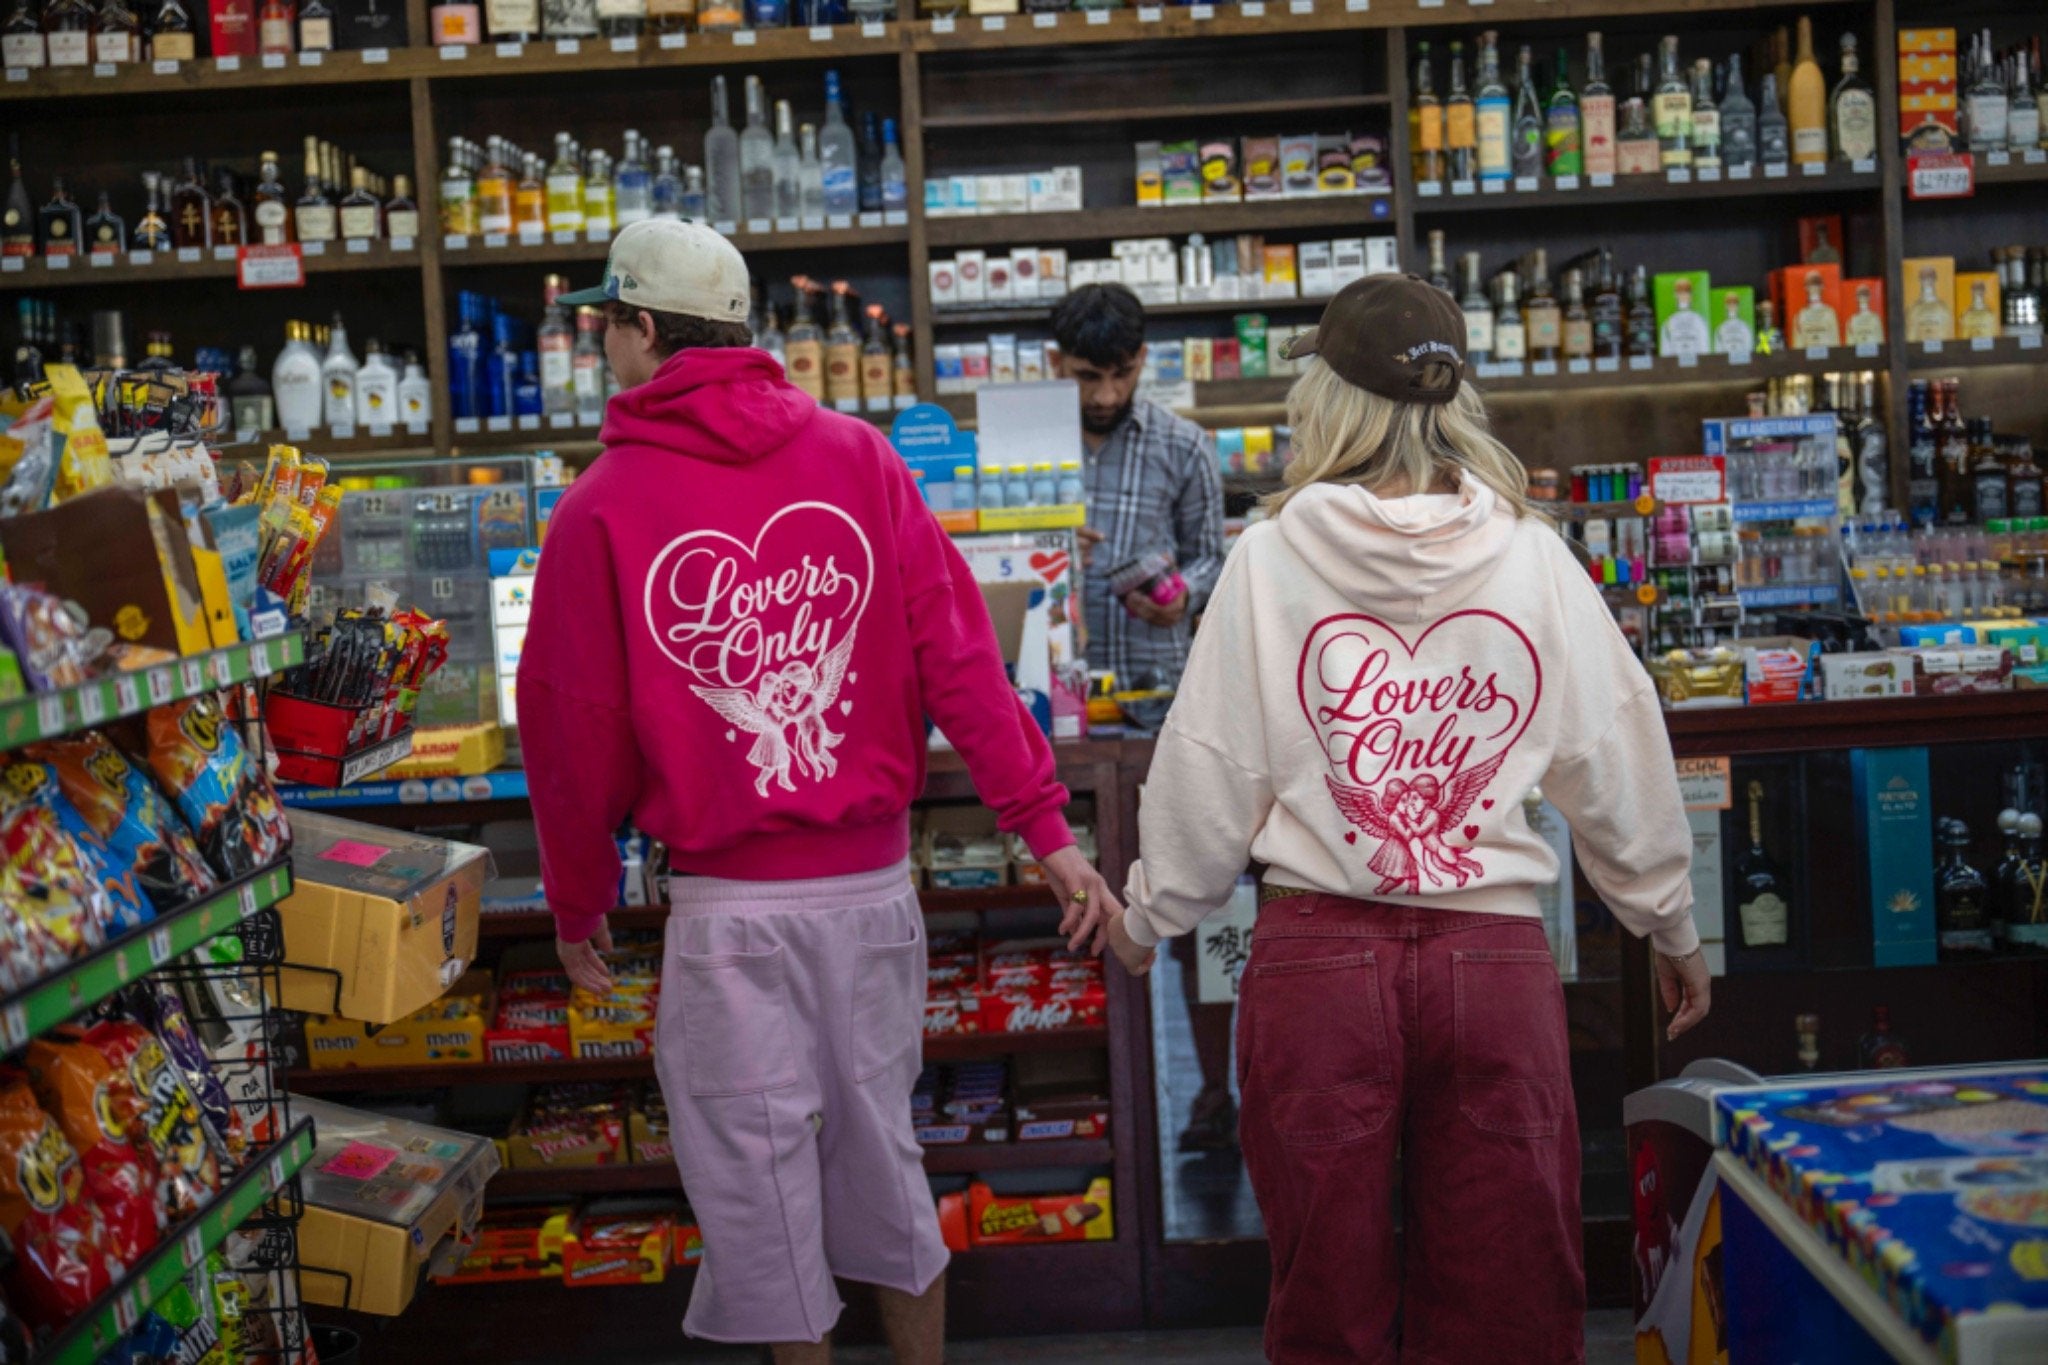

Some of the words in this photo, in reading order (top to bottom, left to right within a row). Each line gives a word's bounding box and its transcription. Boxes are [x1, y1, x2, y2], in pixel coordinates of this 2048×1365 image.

[668, 548, 859, 642] Lovers
[1001, 559, 1012, 576] 5
[690, 601, 833, 687] Only
[1318, 632, 1519, 724] Lovers
[1327, 713, 1475, 786] Only
[1677, 760, 1722, 772] ECIAL
[1007, 1002, 1073, 1031] KitKat
